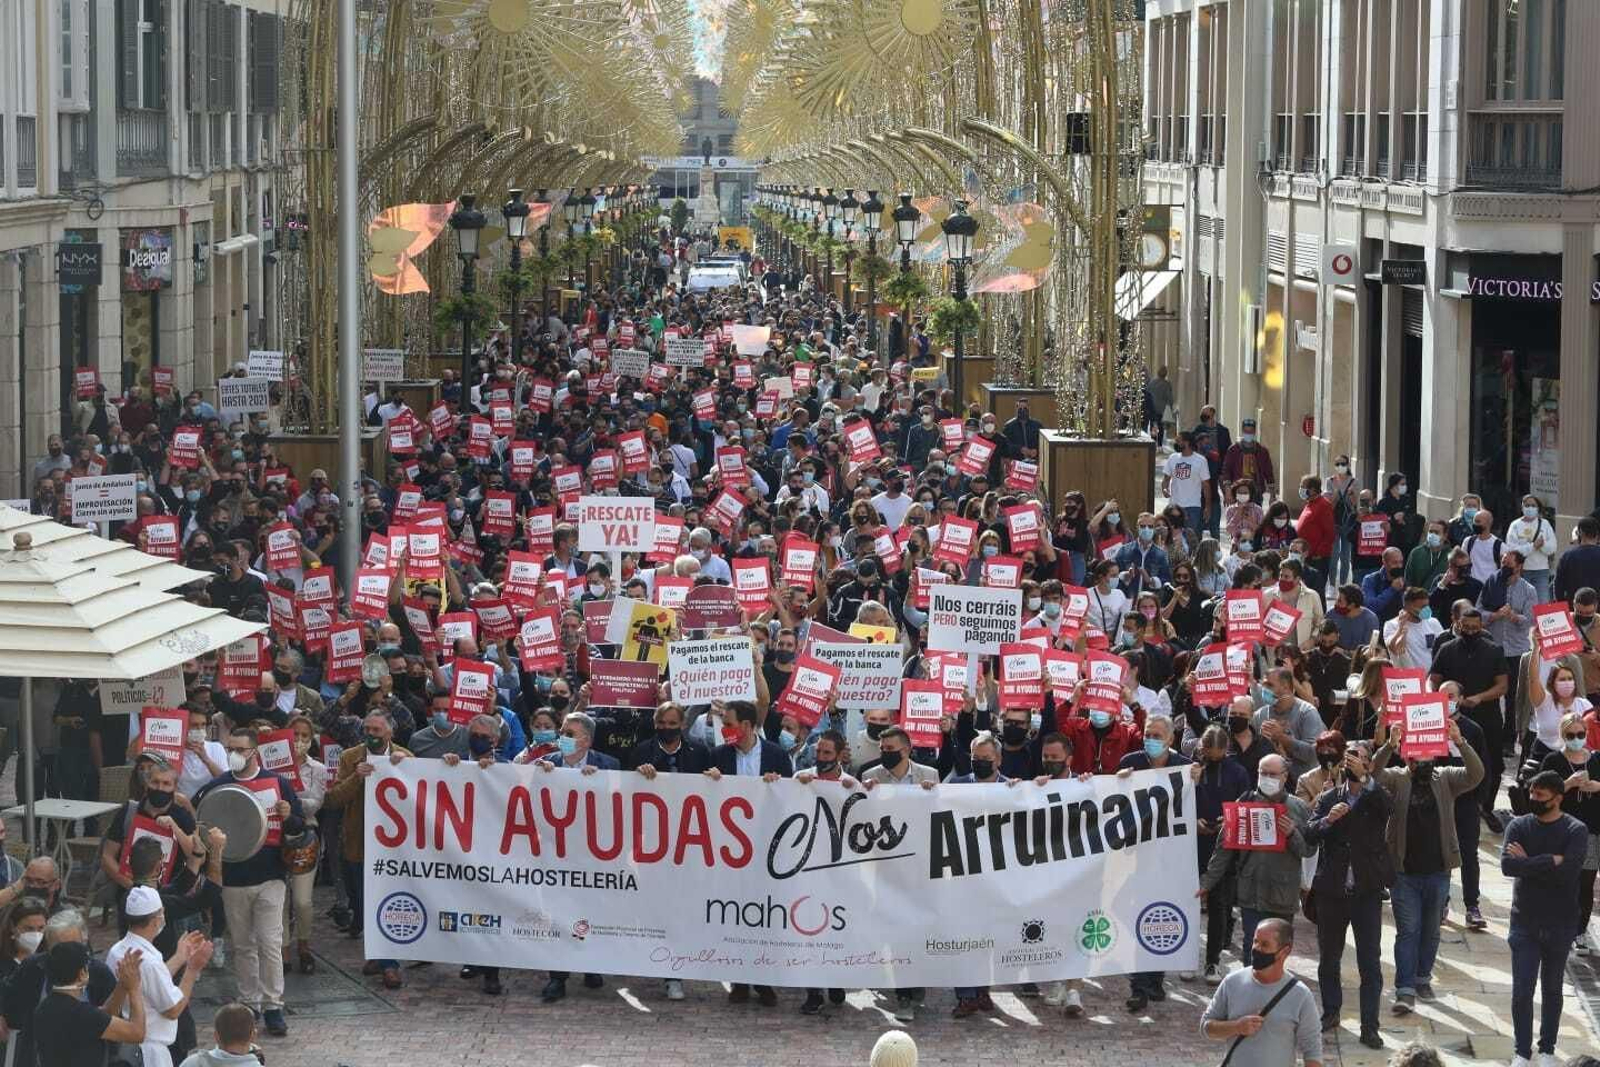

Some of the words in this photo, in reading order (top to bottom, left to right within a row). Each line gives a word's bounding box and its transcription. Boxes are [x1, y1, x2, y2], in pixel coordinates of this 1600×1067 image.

[62, 252, 98, 265] NYX
[1466, 277, 1562, 299] VICTORIA'S
[221, 395, 246, 408] HASTA
[75, 481, 91, 491] Junta
[93, 481, 101, 489] de
[102, 480, 133, 488] Andalucía
[75, 499, 133, 509] IMPROVISACIÓN
[76, 509, 95, 517] Cierre
[97, 508, 107, 516] sin
[109, 507, 133, 516] ayudas
[581, 506, 652, 523] ¡RESCATE
[602, 524, 639, 546] YA!
[934, 595, 962, 612] Nos
[966, 599, 1017, 617] cerráis
[934, 613, 957, 626] PERO
[959, 615, 1017, 631] seguimos
[964, 629, 1015, 644] pagando
[670, 643, 708, 655] Pagamos
[711, 643, 718, 651] el
[720, 641, 749, 650] rescate
[815, 648, 855, 659] Pagamos
[857, 648, 865, 657] el
[867, 650, 900, 658] rescate
[688, 656, 699, 665] de
[700, 655, 707, 664] la
[709, 654, 734, 663] banca
[833, 660, 843, 668] de
[845, 660, 853, 668] la
[855, 660, 882, 669] banca
[673, 667, 717, 687] ¿Quién
[719, 669, 751, 686] paga
[863, 675, 897, 690] paga
[679, 688, 690, 699] el
[694, 682, 749, 698] nuestro?
[374, 777, 475, 853] SIN
[499, 785, 754, 869] AYUDAS
[766, 791, 909, 881] Nos
[929, 771, 1187, 880] Arruinan!
[372, 859, 638, 891] #SALVEMOSLAHOSTELERÍA
[821, 951, 912, 966] hosteleros
[1001, 950, 1062, 963] HOSTELEROS
